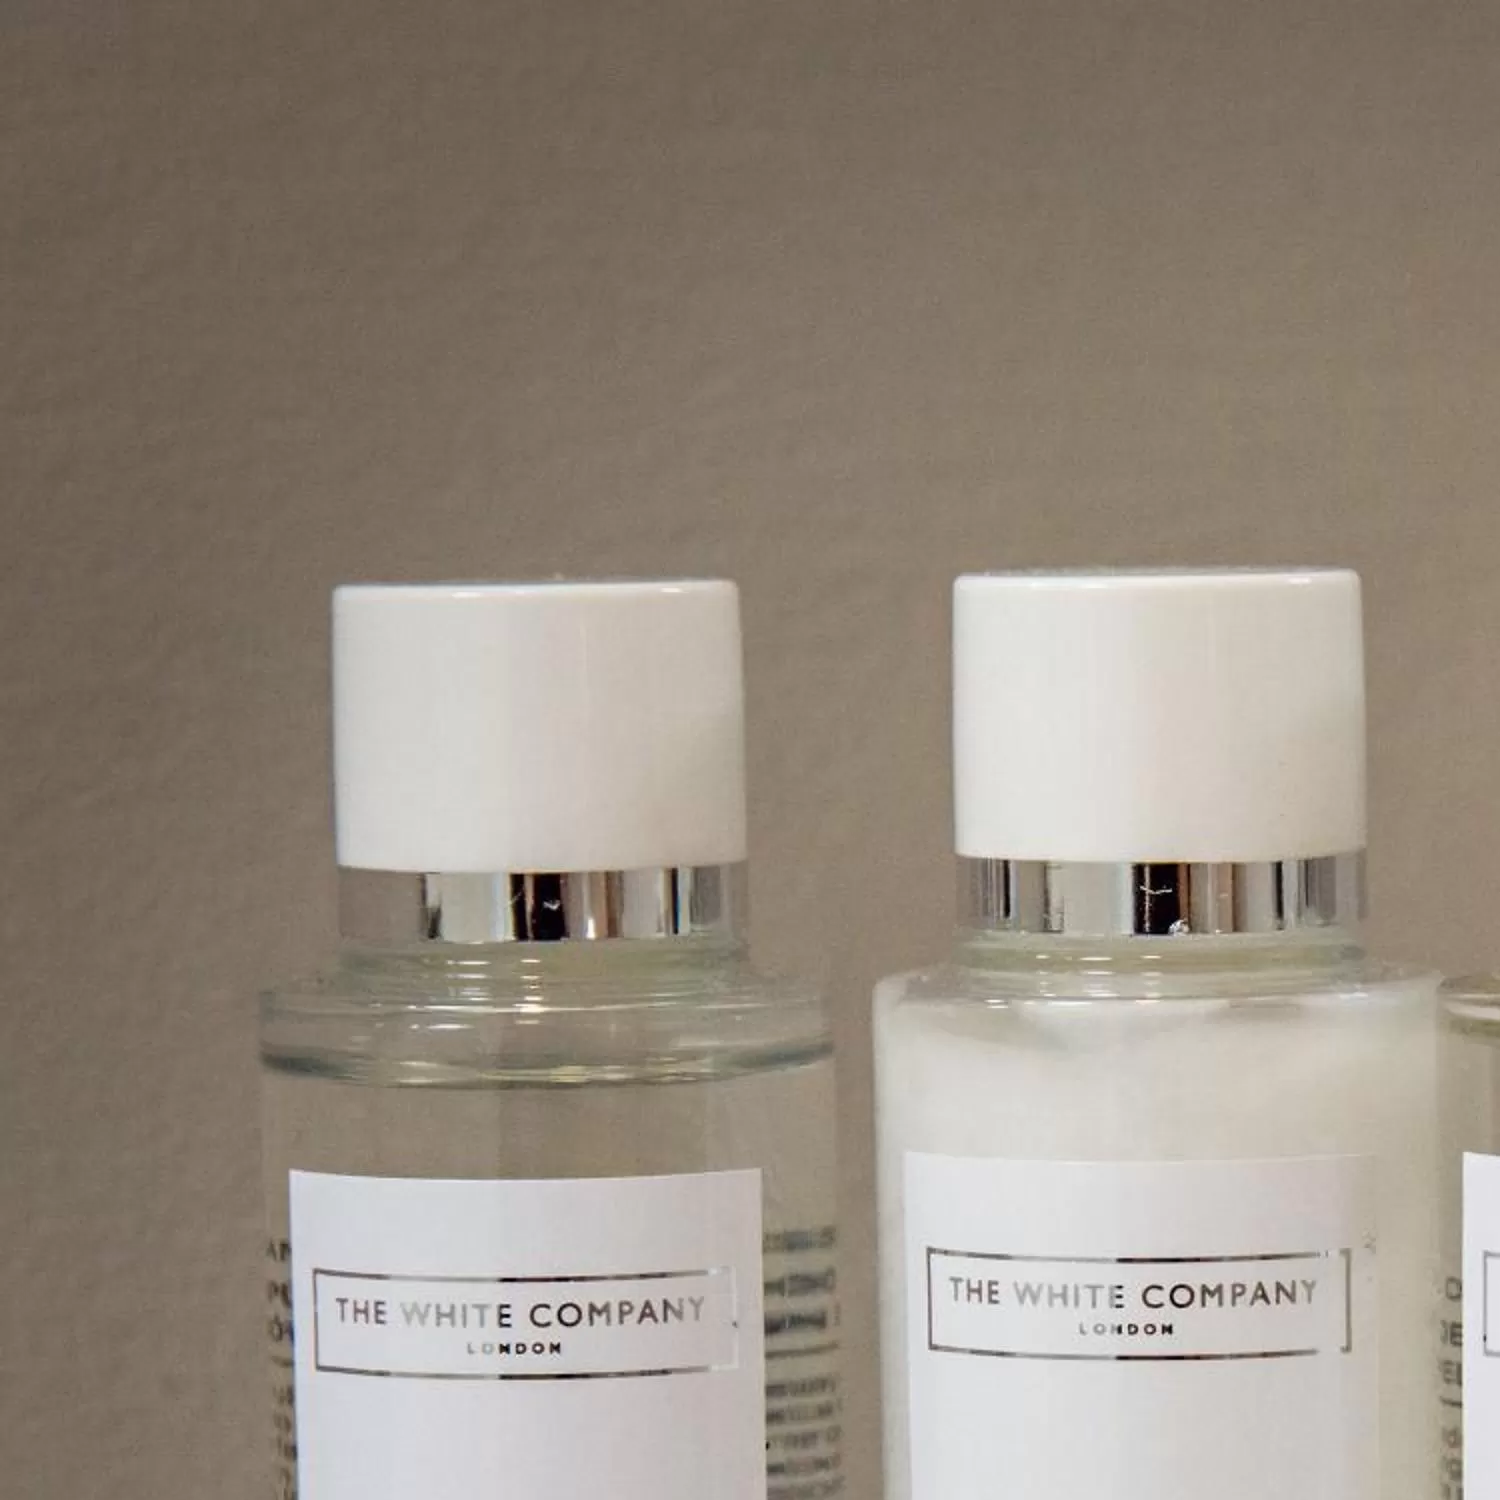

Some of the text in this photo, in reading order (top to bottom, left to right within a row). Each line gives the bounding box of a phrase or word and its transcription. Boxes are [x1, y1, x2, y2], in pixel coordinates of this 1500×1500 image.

[949, 1277, 1318, 1309] THE WHITE COMPANY
[336, 1297, 705, 1329] THE WHITE COMPANY
[1079, 1323, 1174, 1336] LONDON
[467, 1342, 562, 1356] LONDON
